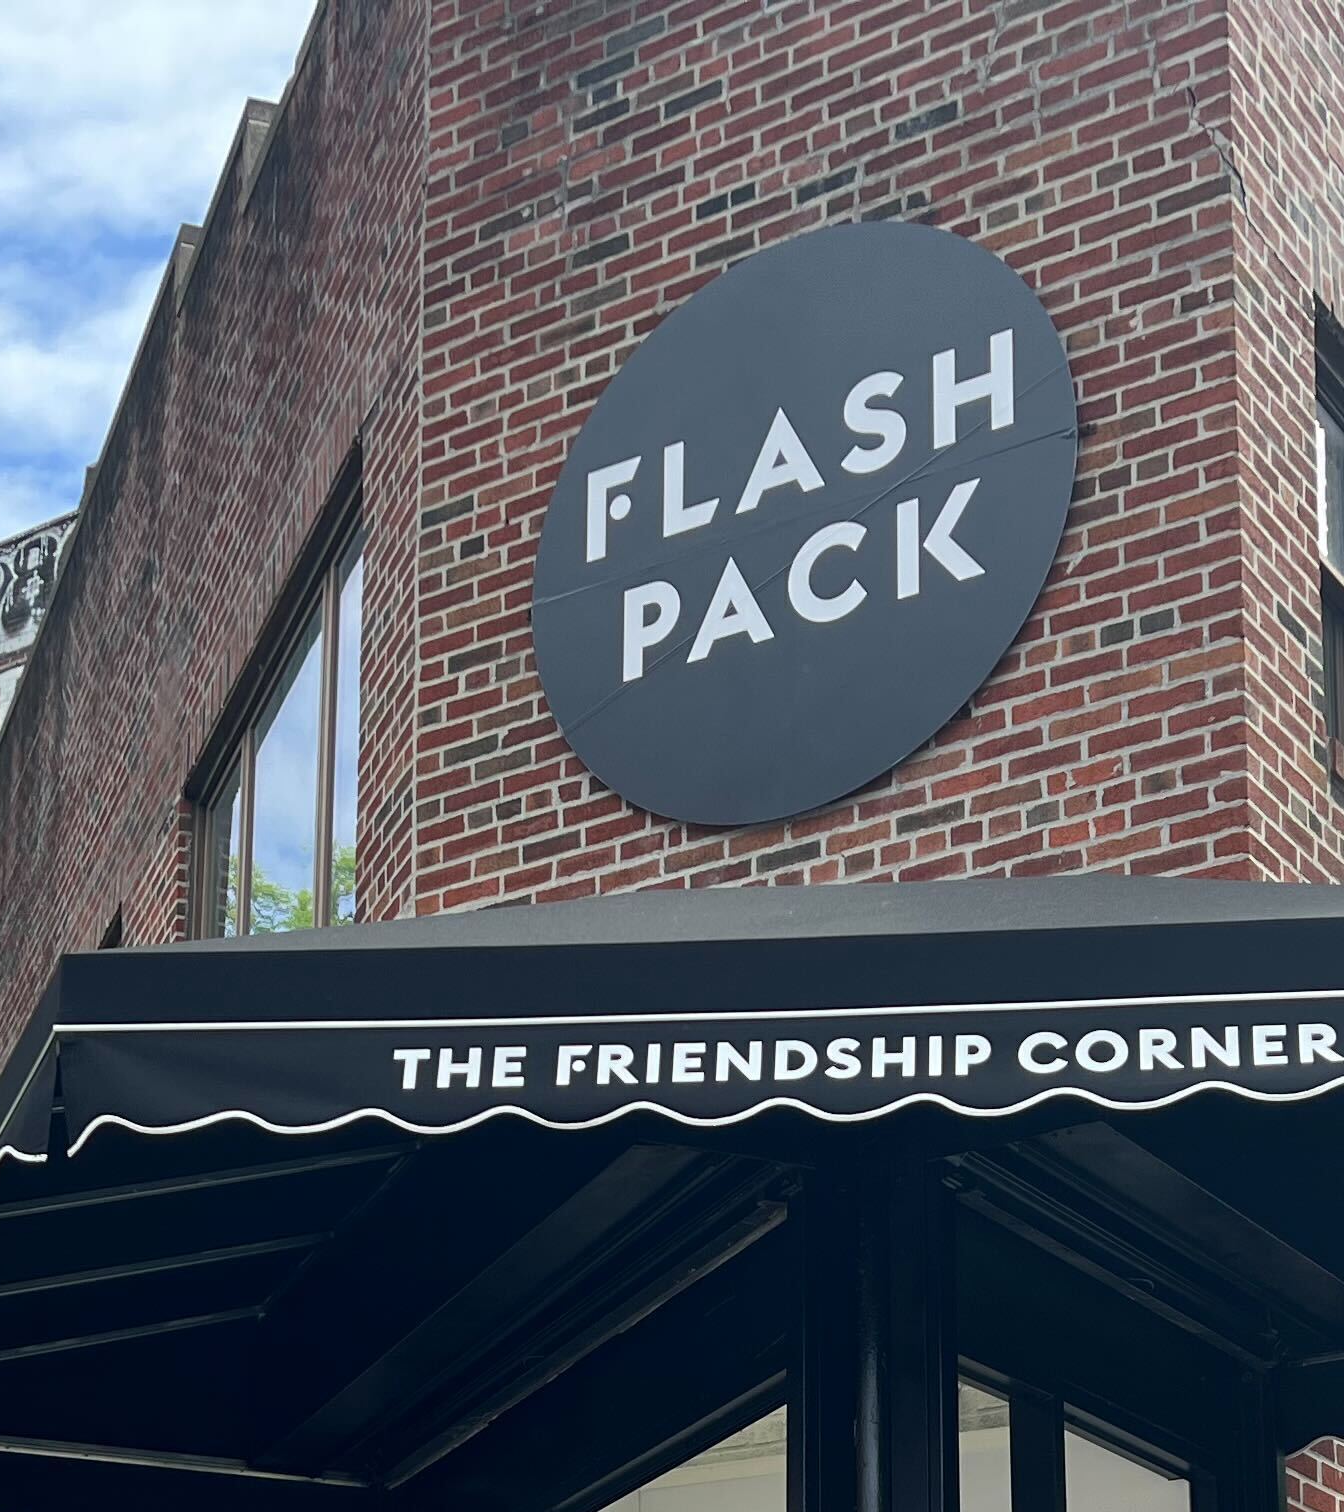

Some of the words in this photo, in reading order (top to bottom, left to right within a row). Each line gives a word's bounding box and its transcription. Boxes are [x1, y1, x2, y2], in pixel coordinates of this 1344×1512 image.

[587, 329, 1013, 562] FLASH
[623, 478, 985, 682] PACK
[394, 1047, 526, 1089] THE
[556, 1035, 991, 1085] FRIENDSHIP
